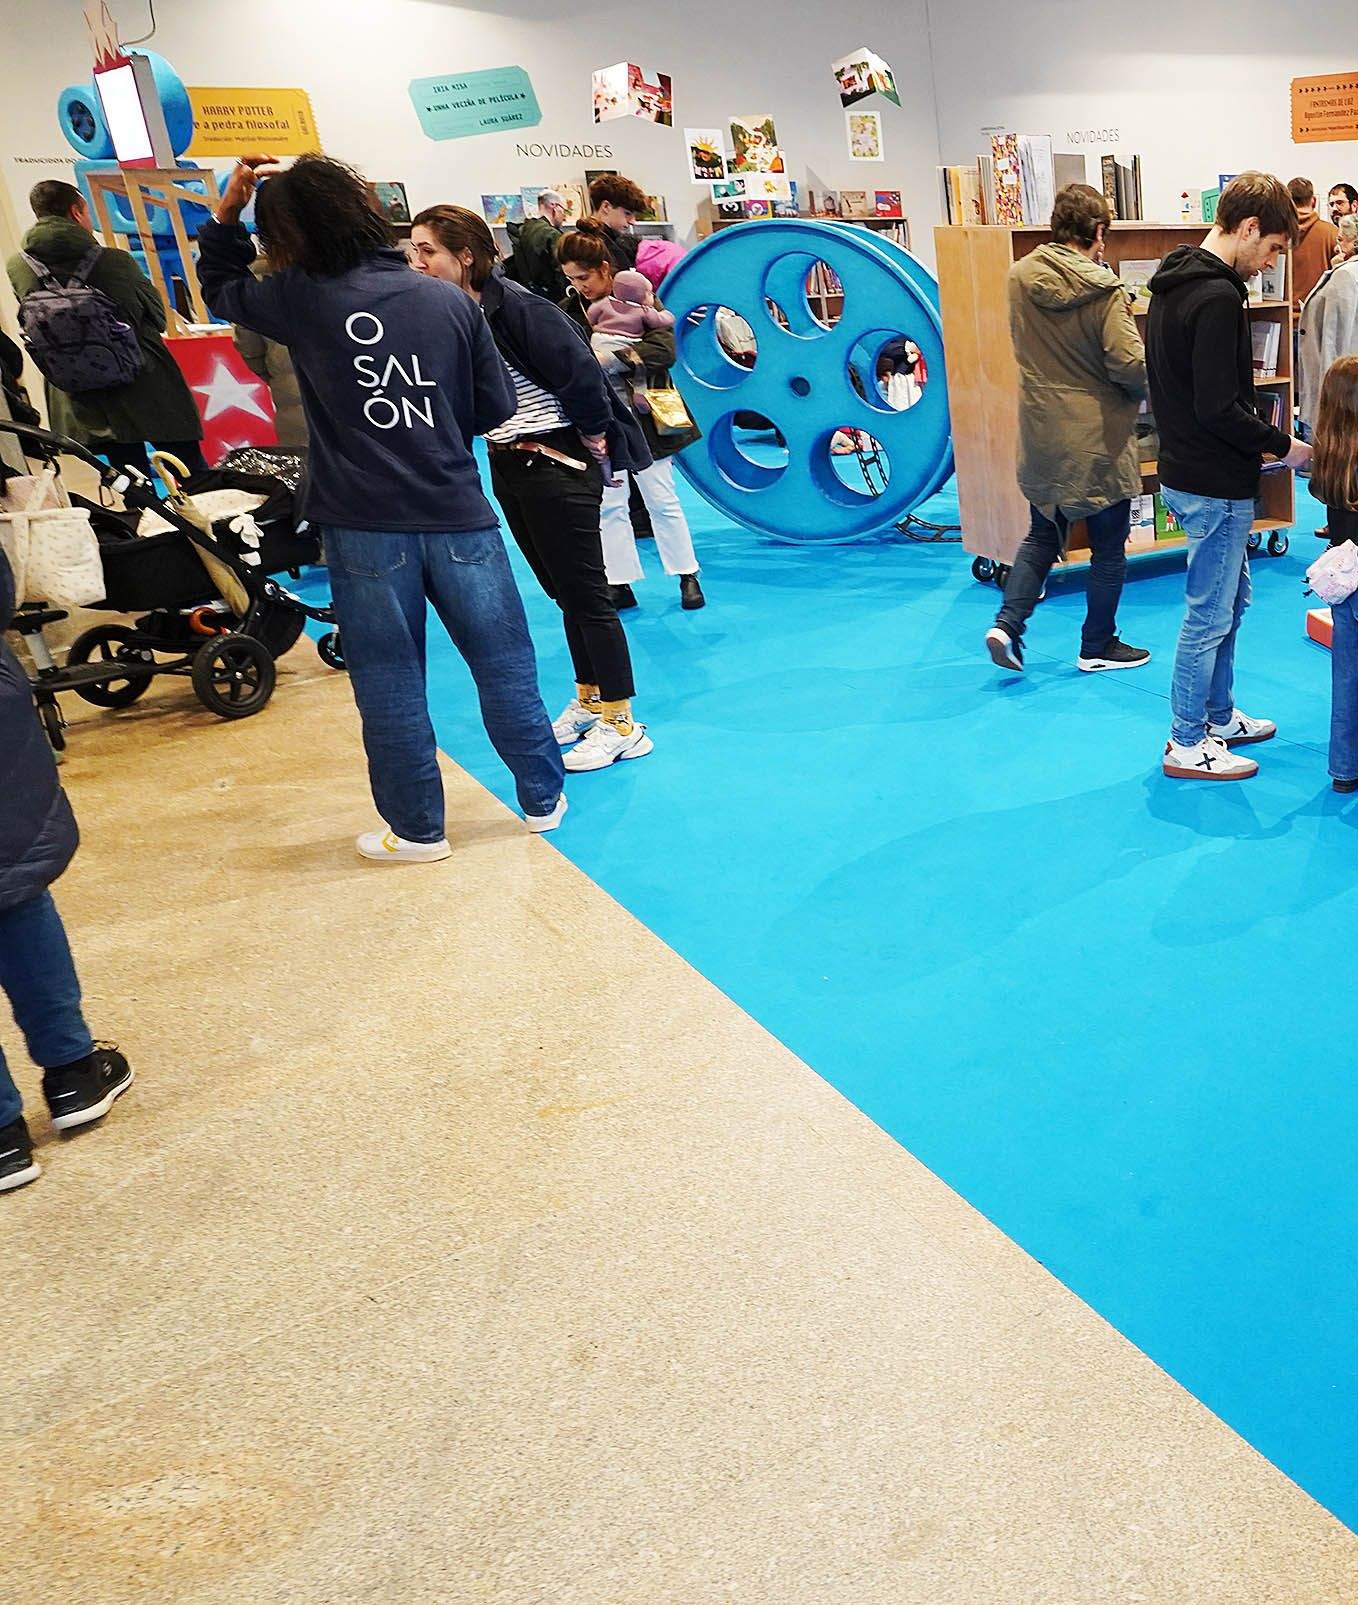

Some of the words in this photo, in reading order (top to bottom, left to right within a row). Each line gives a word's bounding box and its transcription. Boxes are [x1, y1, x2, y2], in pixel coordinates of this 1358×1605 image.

[202, 106, 236, 116] HARRY
[238, 106, 274, 116] POTTER
[203, 120, 209, 129] a
[212, 119, 242, 131] pedra
[245, 119, 290, 129] filosofal
[1066, 128, 1120, 144] NOVIDADES
[516, 143, 614, 159] NOVIDADES
[345, 311, 384, 345] O
[353, 354, 437, 388] SAL
